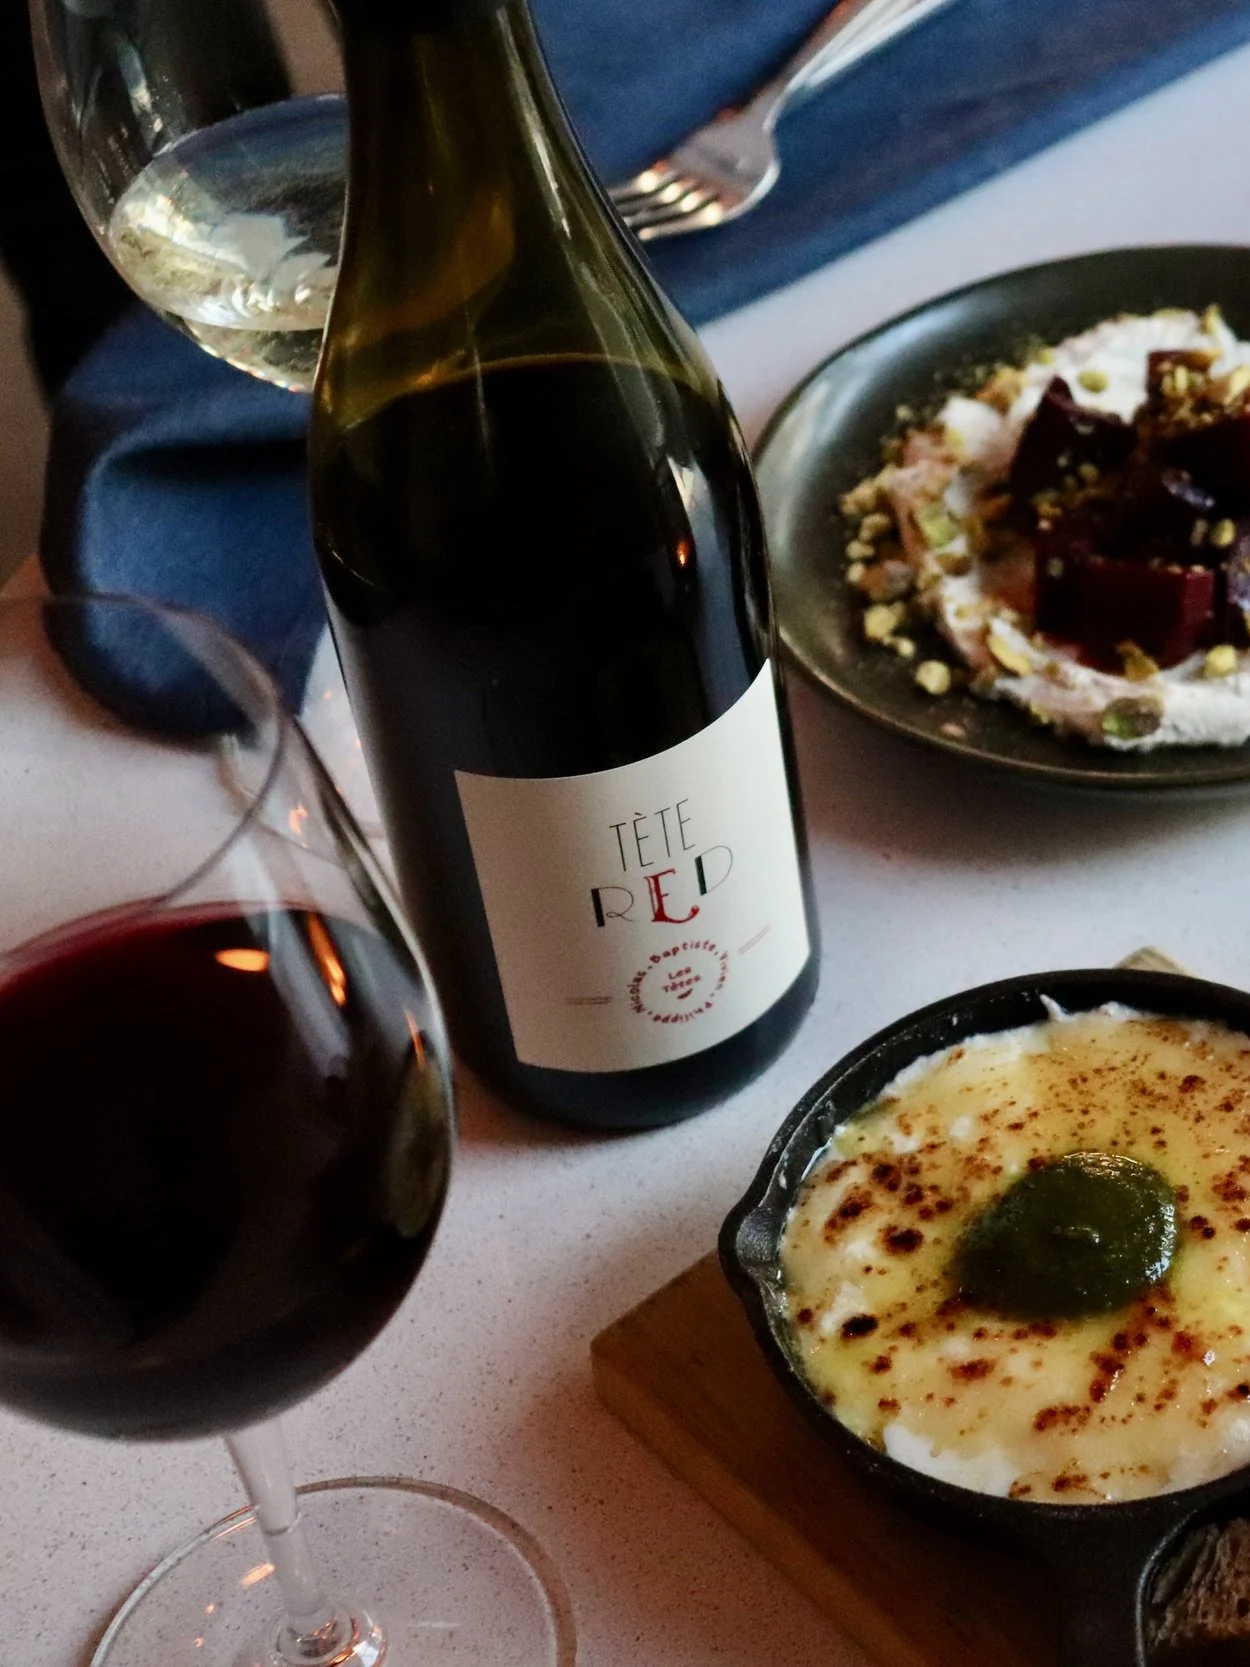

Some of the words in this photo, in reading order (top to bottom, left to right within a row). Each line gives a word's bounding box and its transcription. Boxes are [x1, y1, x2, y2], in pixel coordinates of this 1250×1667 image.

[609, 798, 695, 872] TÈTE
[591, 845, 733, 927] RED
[649, 939, 716, 963] Baptiste
